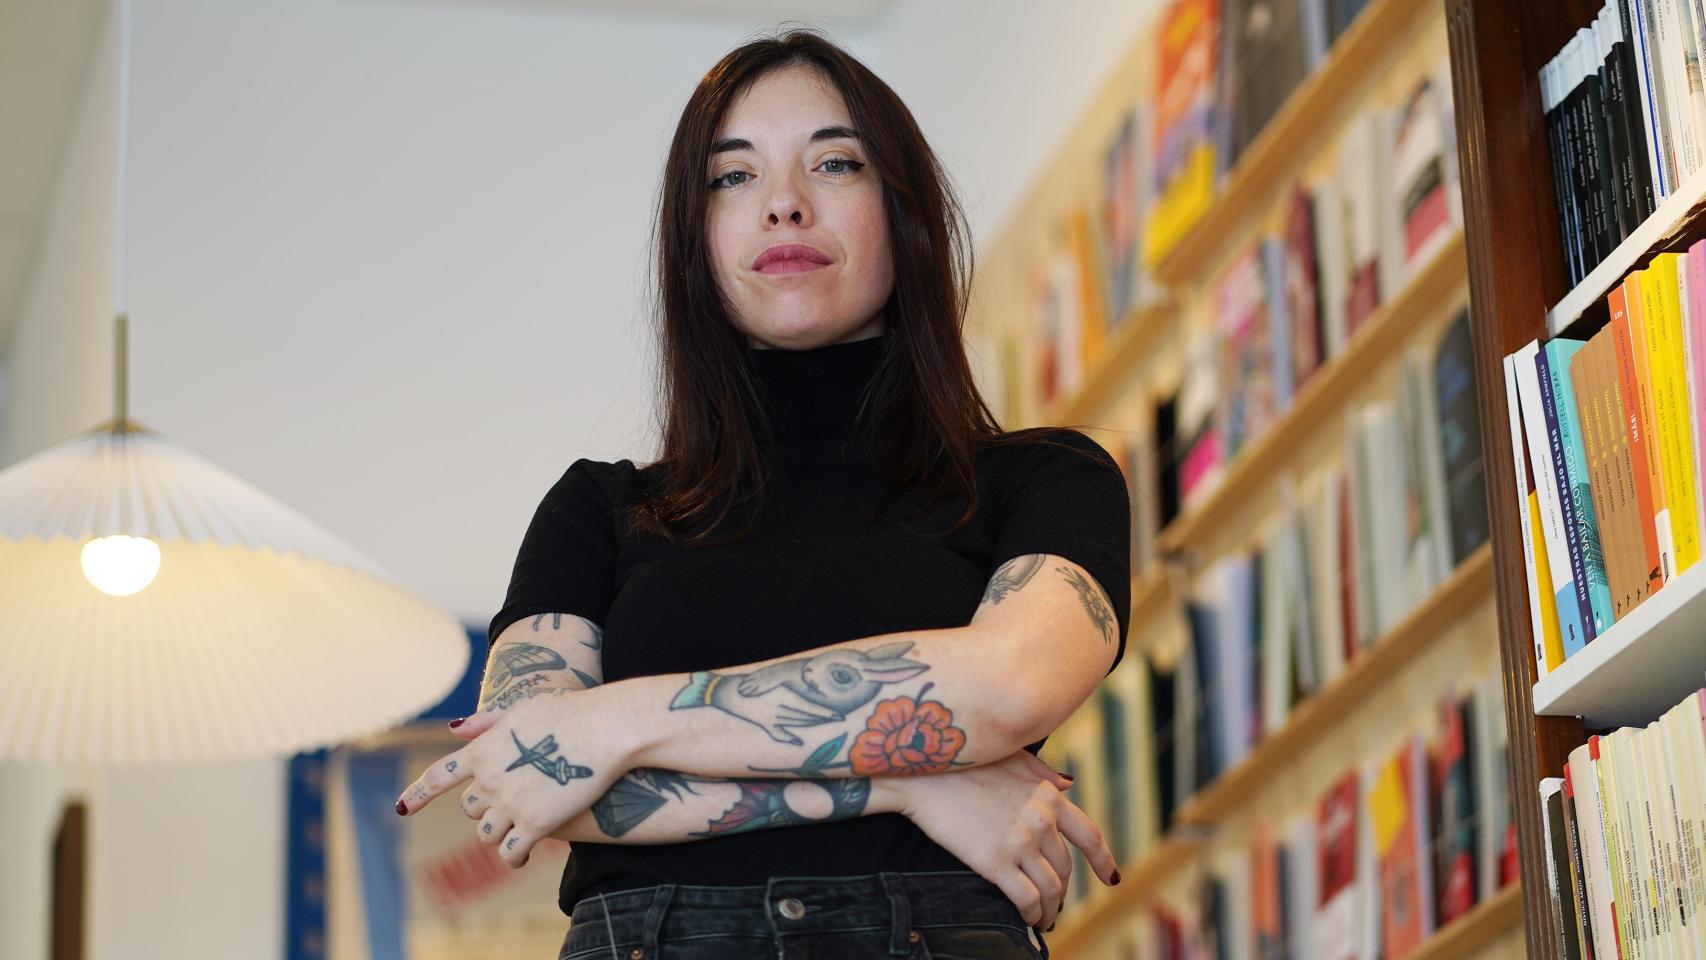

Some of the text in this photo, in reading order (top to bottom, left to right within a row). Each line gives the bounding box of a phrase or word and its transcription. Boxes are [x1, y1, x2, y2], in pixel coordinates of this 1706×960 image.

[1541, 362, 1554, 419] JULIA ARMFIELD
[1552, 369, 1568, 438] RUSSELL HOBAN
[1551, 427, 1586, 601] NUESTRAS ESPOSAS BAJO EL MAR
[1565, 445, 1596, 590] VEN A BAILAR CONMIGO
